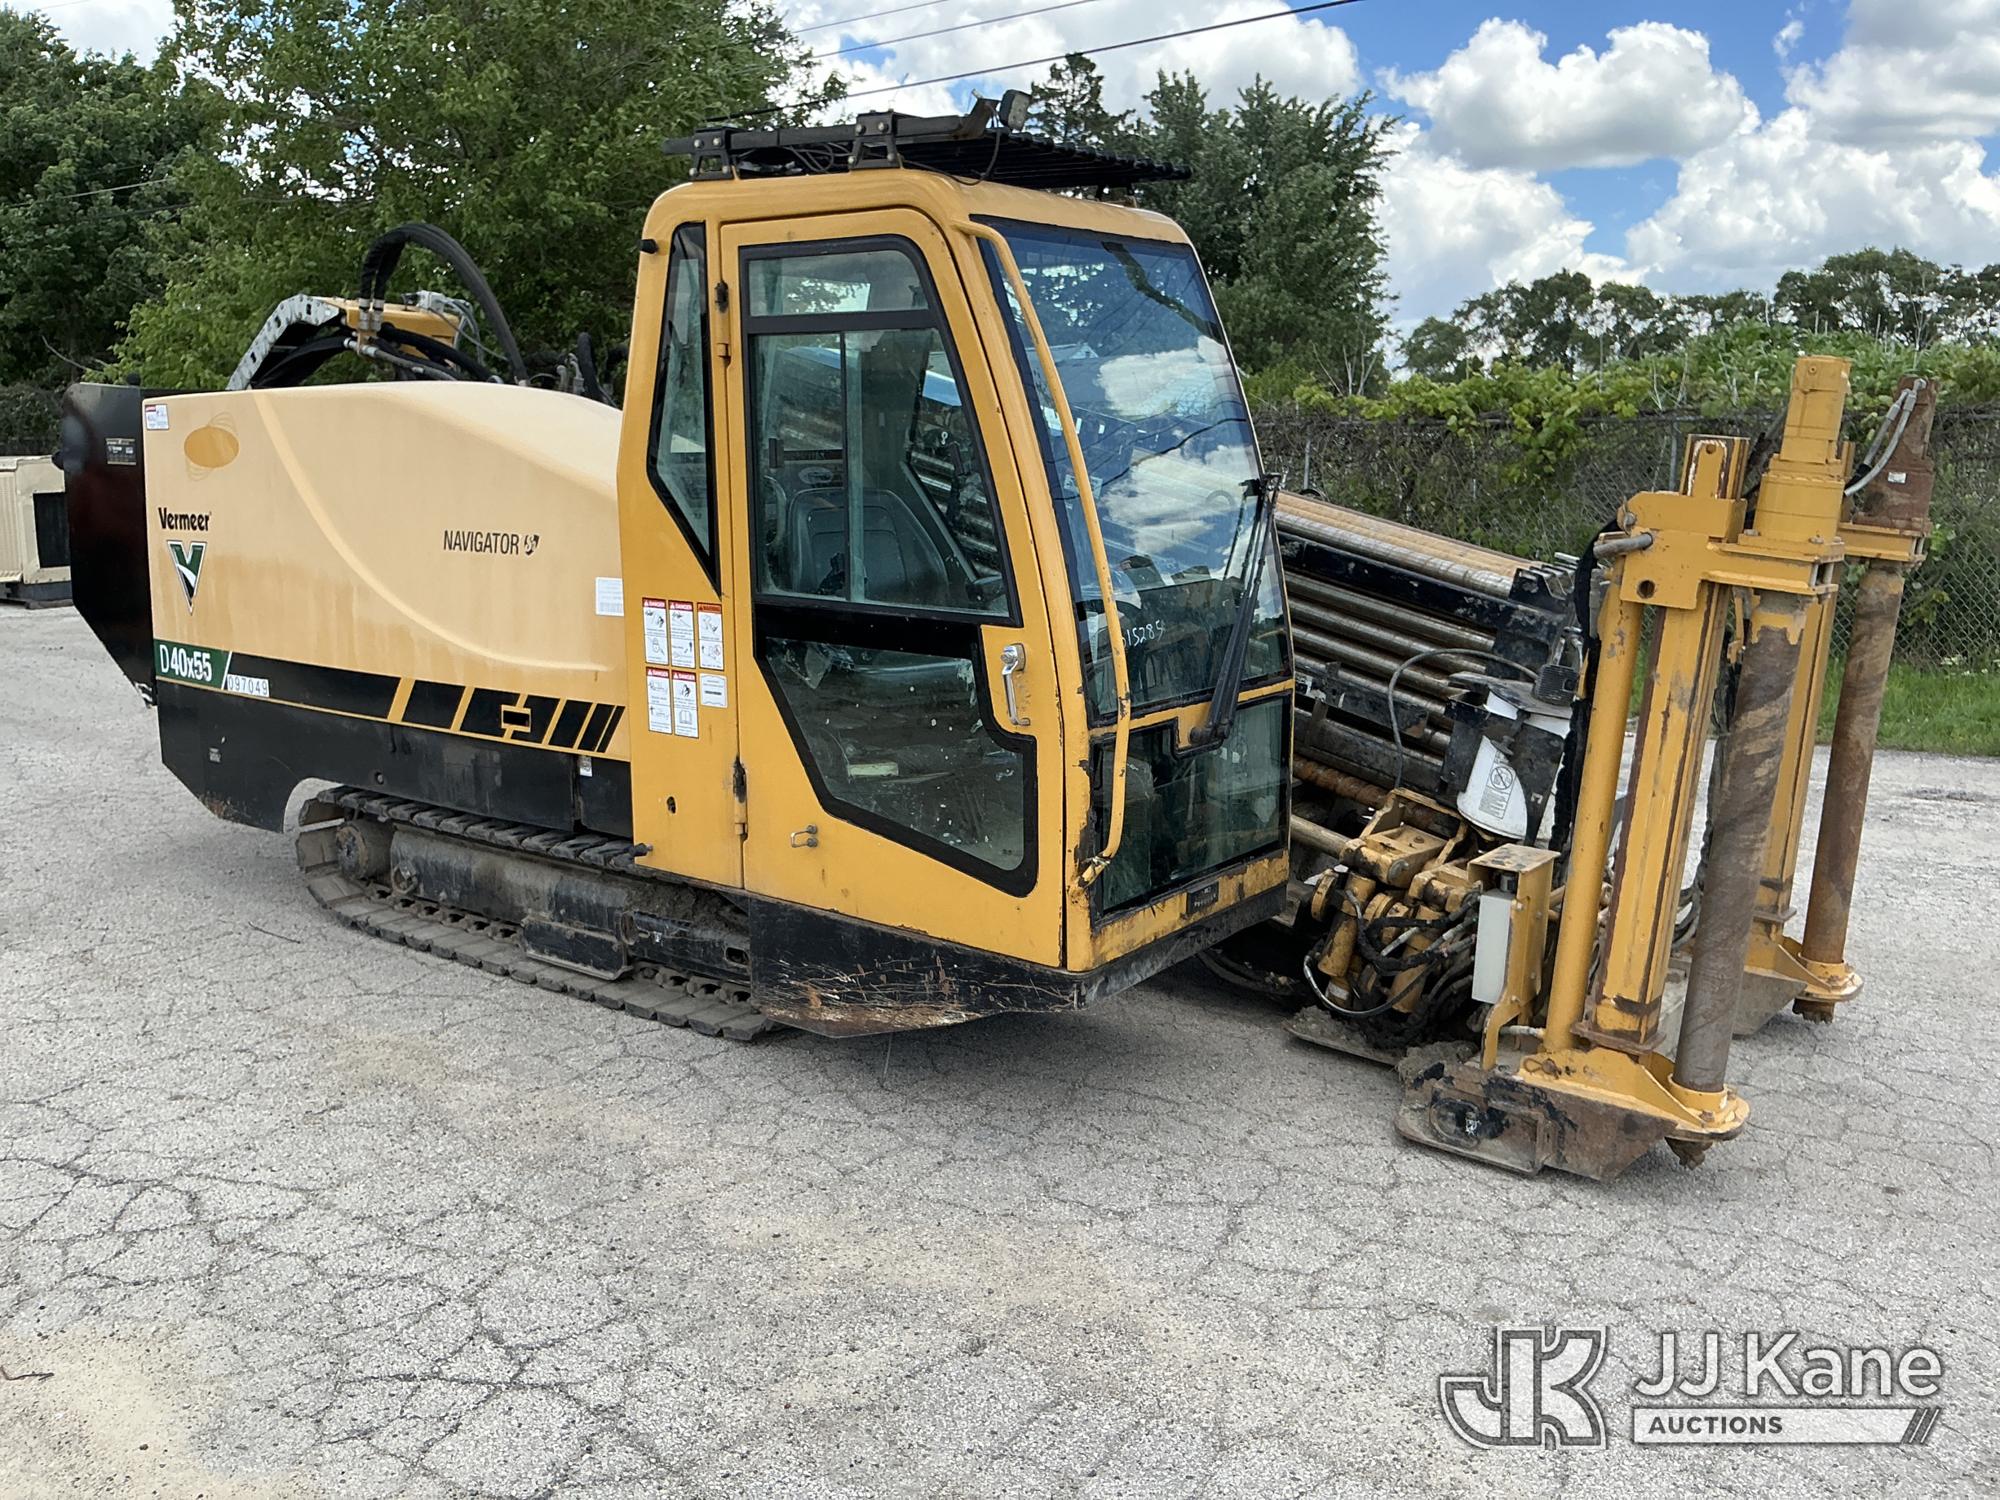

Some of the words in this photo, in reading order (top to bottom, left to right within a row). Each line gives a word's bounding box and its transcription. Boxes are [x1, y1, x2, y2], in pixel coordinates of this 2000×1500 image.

[157, 507, 210, 531] Vermeer
[443, 529, 520, 555] NAVIGATOR
[159, 644, 212, 682] D40x55
[228, 675, 268, 695] 097049
